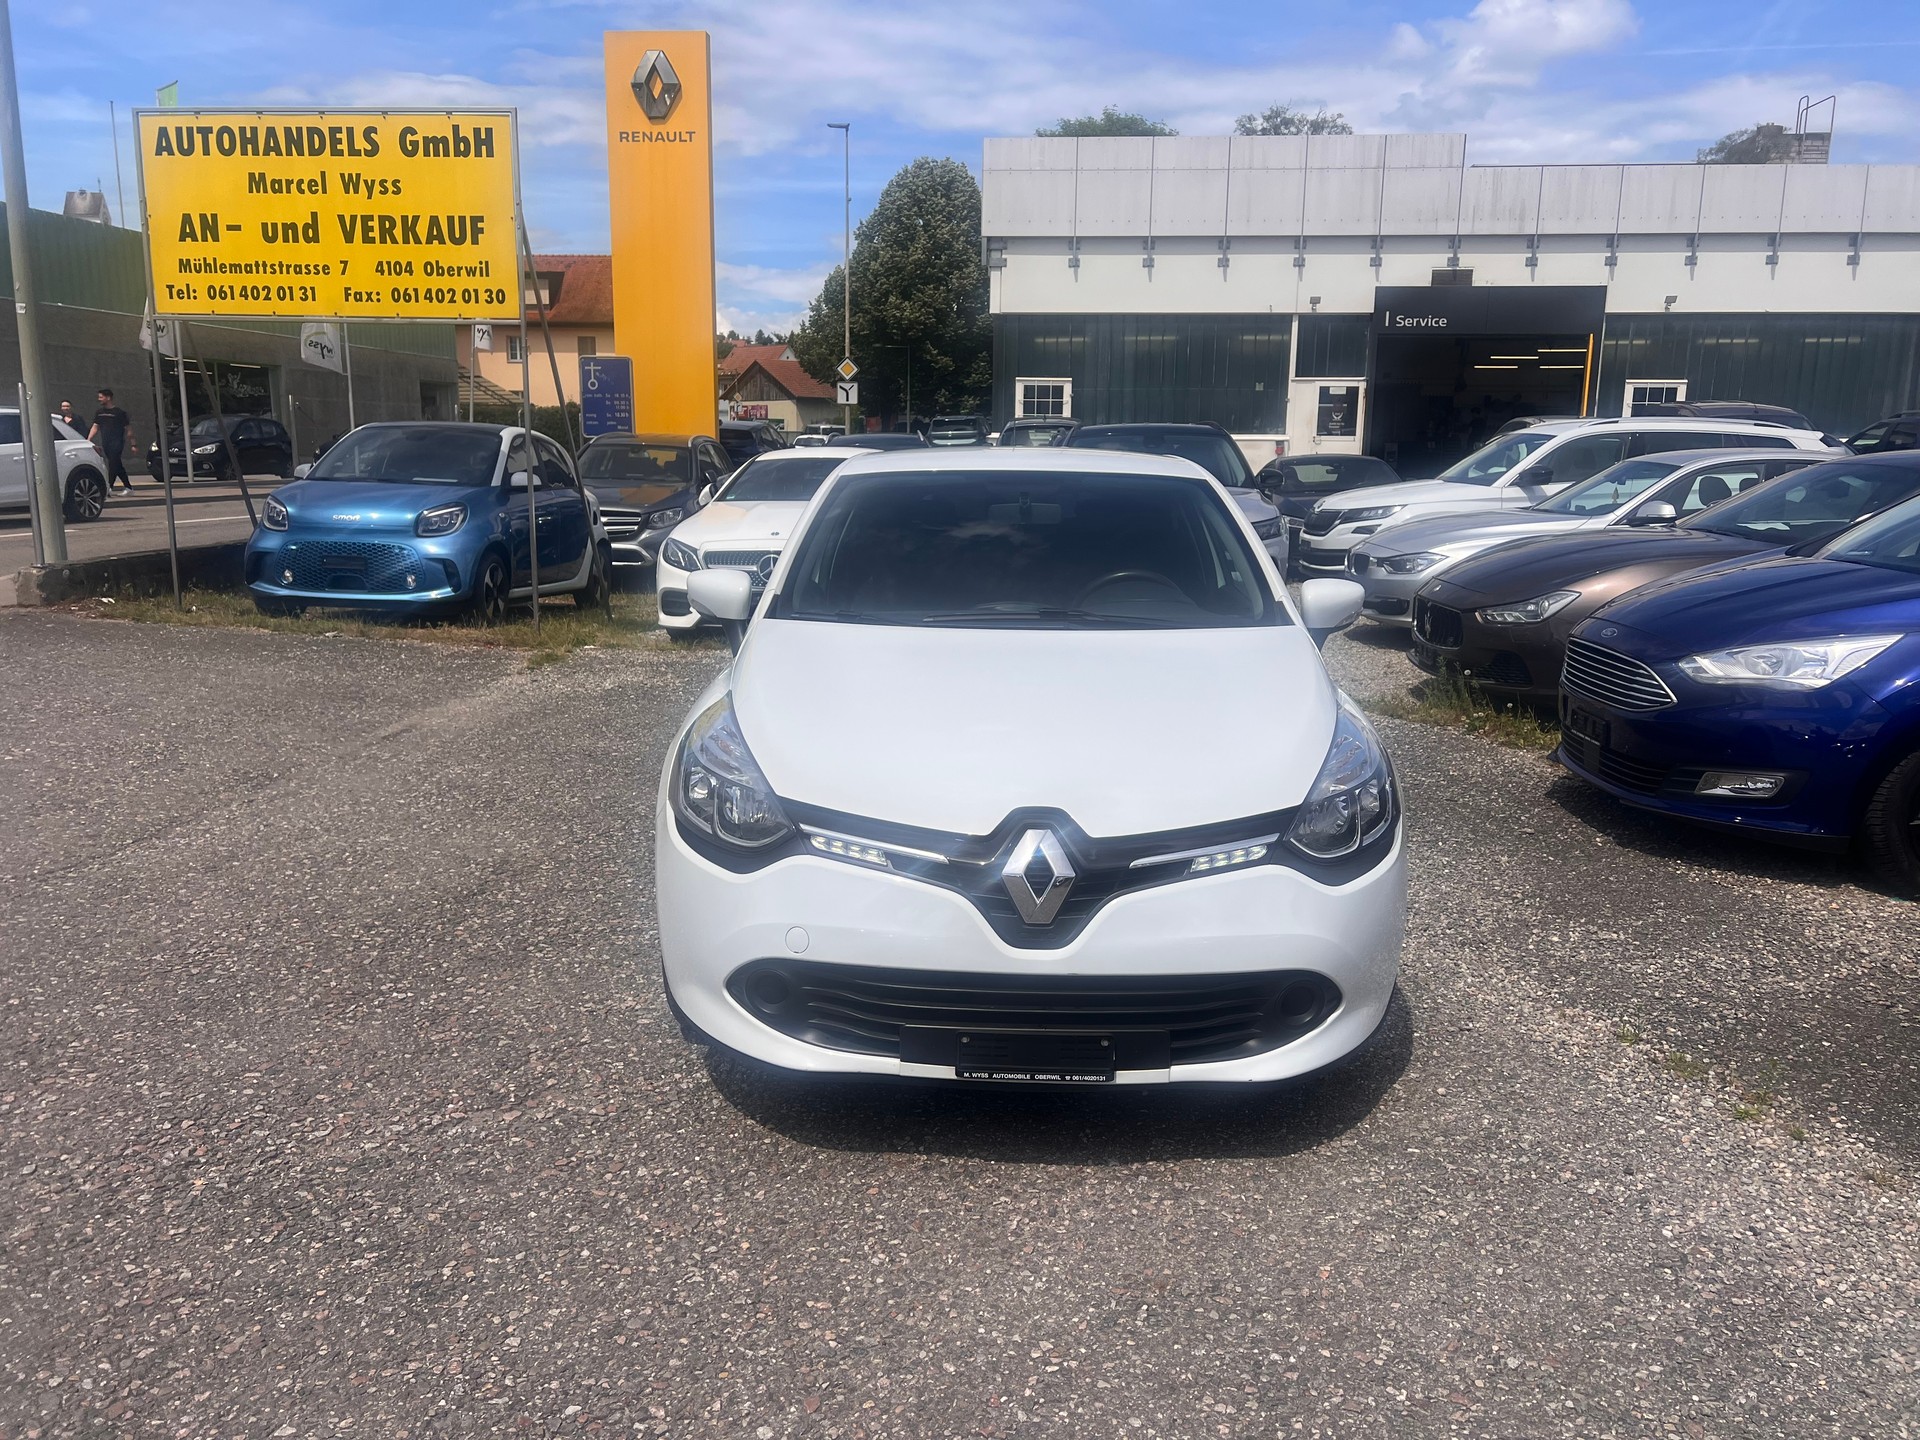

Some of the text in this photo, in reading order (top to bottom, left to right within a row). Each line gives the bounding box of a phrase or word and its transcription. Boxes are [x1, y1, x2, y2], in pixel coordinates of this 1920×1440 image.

[155, 124, 495, 158] AUTOHANDELS GmbH
[619, 131, 696, 143] RENAULT
[248, 171, 402, 200] Marcel Wyss
[261, 212, 320, 244] und
[337, 215, 485, 246] VERKAUF
[178, 257, 490, 278] Mühlemattstrasse 7 4104 Oberwil
[166, 284, 198, 300] Tel:
[344, 287, 381, 303] Fax:
[1395, 315, 1448, 327] Service
